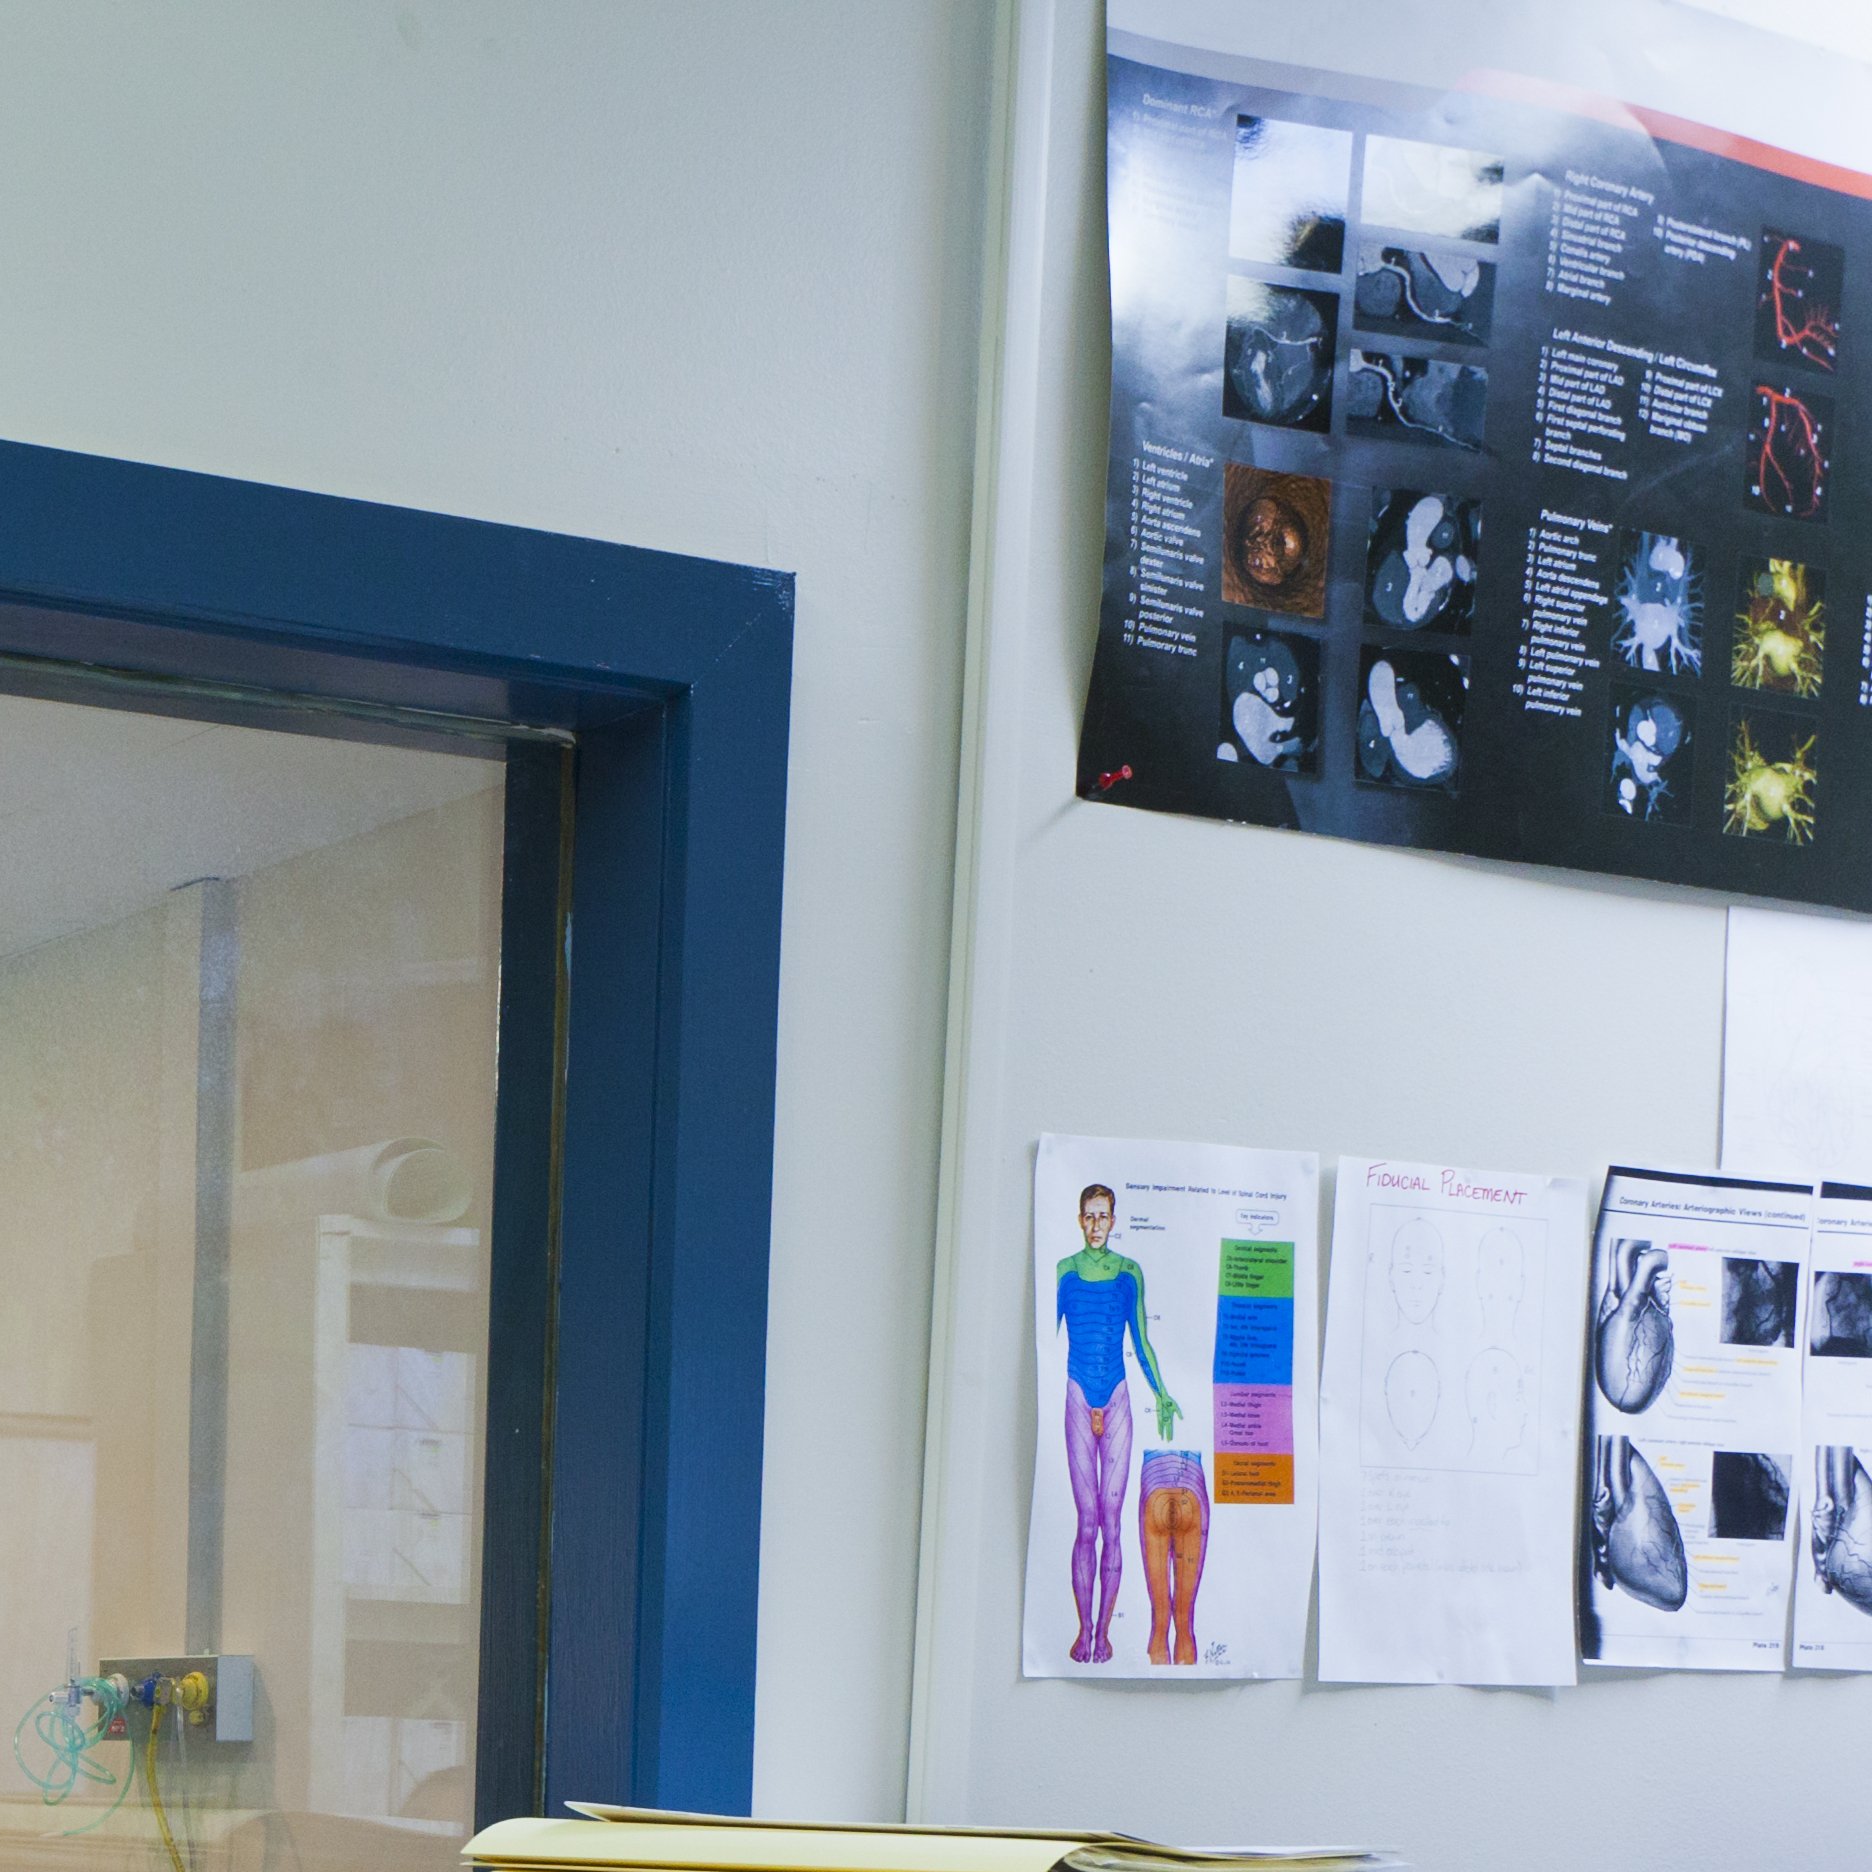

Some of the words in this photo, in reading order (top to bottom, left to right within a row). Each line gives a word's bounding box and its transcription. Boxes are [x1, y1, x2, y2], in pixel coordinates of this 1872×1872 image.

[1142, 440, 1183, 462] Ventricles
[1142, 460, 1156, 473] Left
[1156, 465, 1188, 482] ventricle
[1142, 473, 1156, 487] Left
[1157, 479, 1181, 493] atrium
[1141, 487, 1161, 502] Right
[1161, 493, 1193, 509] ventricle
[1141, 500, 1161, 515] Right
[1162, 508, 1185, 521] atrium
[1141, 514, 1160, 529] Aorta
[1540, 508, 1586, 530] Pulmonary
[1164, 534, 1184, 547] valve
[1539, 529, 1562, 543] Aortic
[1563, 535, 1579, 546] arch
[1140, 555, 1164, 569] dexter
[1185, 552, 1205, 565] valve
[1537, 555, 1551, 567] Left
[1185, 578, 1205, 592] valve
[1536, 581, 1550, 593] Left
[1534, 594, 1555, 608] Right
[1139, 610, 1173, 625] posterior
[1184, 605, 1204, 618] valve
[1532, 620, 1553, 635] Right
[1572, 617, 1588, 627] vein
[1181, 631, 1196, 643] vein
[1570, 643, 1586, 653] vein
[1530, 646, 1545, 659] Left
[1584, 658, 1600, 669] vein
[1528, 659, 1544, 672] Left
[1527, 686, 1542, 698] Left
[1568, 681, 1584, 692] vein
[1566, 707, 1582, 718] vein
[1125, 1182, 1150, 1191] Sensory
[1152, 1184, 1185, 1193] Impairment
[1366, 1162, 1430, 1191] FIDUCIAL
[1441, 1169, 1528, 1205] PLACEMENT
[1619, 1196, 1649, 1209] Coronary
[1683, 1203, 1736, 1217] Arteriographic
[1739, 1207, 1762, 1218] Views
[1764, 1209, 1806, 1222] (continued)
